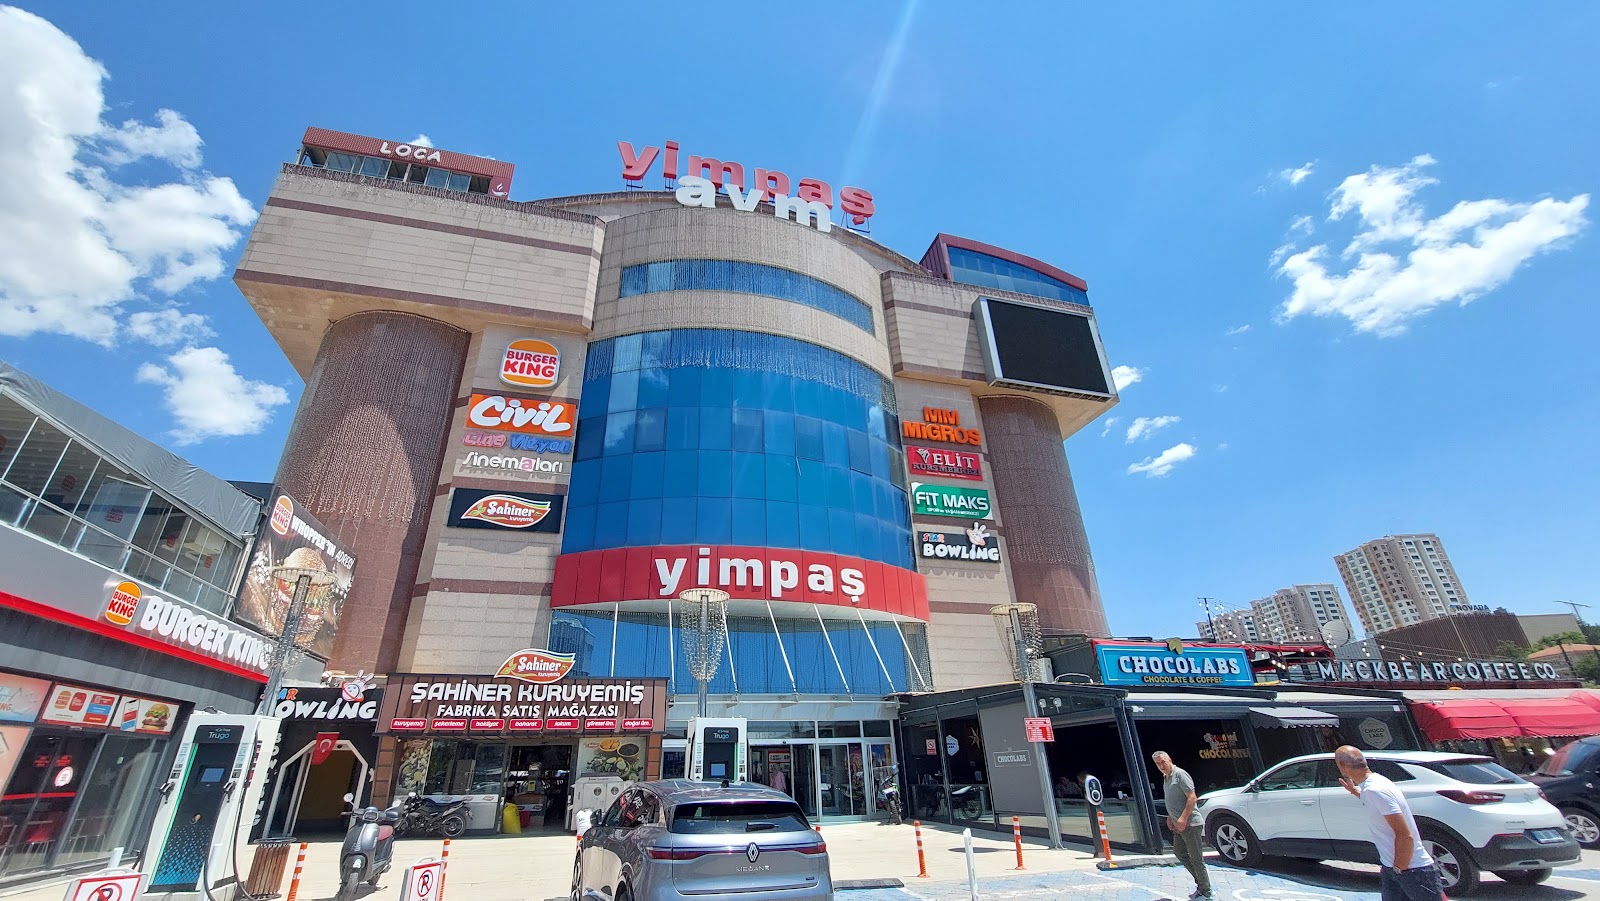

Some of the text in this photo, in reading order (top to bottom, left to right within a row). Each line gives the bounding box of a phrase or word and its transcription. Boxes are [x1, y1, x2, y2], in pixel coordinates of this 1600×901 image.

[380, 142, 441, 162] LOCA
[617, 140, 876, 225] yimpaş
[675, 175, 831, 233] avm
[506, 350, 557, 366] BURGER
[503, 360, 555, 378] KING
[923, 406, 961, 426] MM
[276, 503, 291, 519] BURGER
[486, 501, 535, 517] Şahiner
[942, 494, 989, 510] MAKS
[272, 510, 289, 529] KING
[922, 533, 945, 543] STAR
[655, 547, 866, 603] yimpaş
[113, 591, 138, 606] BURGER
[108, 600, 135, 618] KING
[140, 595, 273, 670] BURGER KING
[517, 656, 561, 672] Şahiner
[1118, 655, 1241, 675] CHOCOLABS
[1318, 661, 1560, 681] MACKBEAR COFFEE CO.
[1143, 675, 1223, 684] CHOCOLATE & COFFEE
[411, 679, 645, 705] ŞAHİNER KURUYEMİŞ
[274, 698, 377, 720] OWLING
[502, 705, 540, 719] SATIŞ
[547, 703, 619, 717] MAĞAZASI
[208, 731, 230, 740] Trugo
[713, 732, 730, 740] Trugo
[997, 754, 1027, 763] CHOCOLABS
